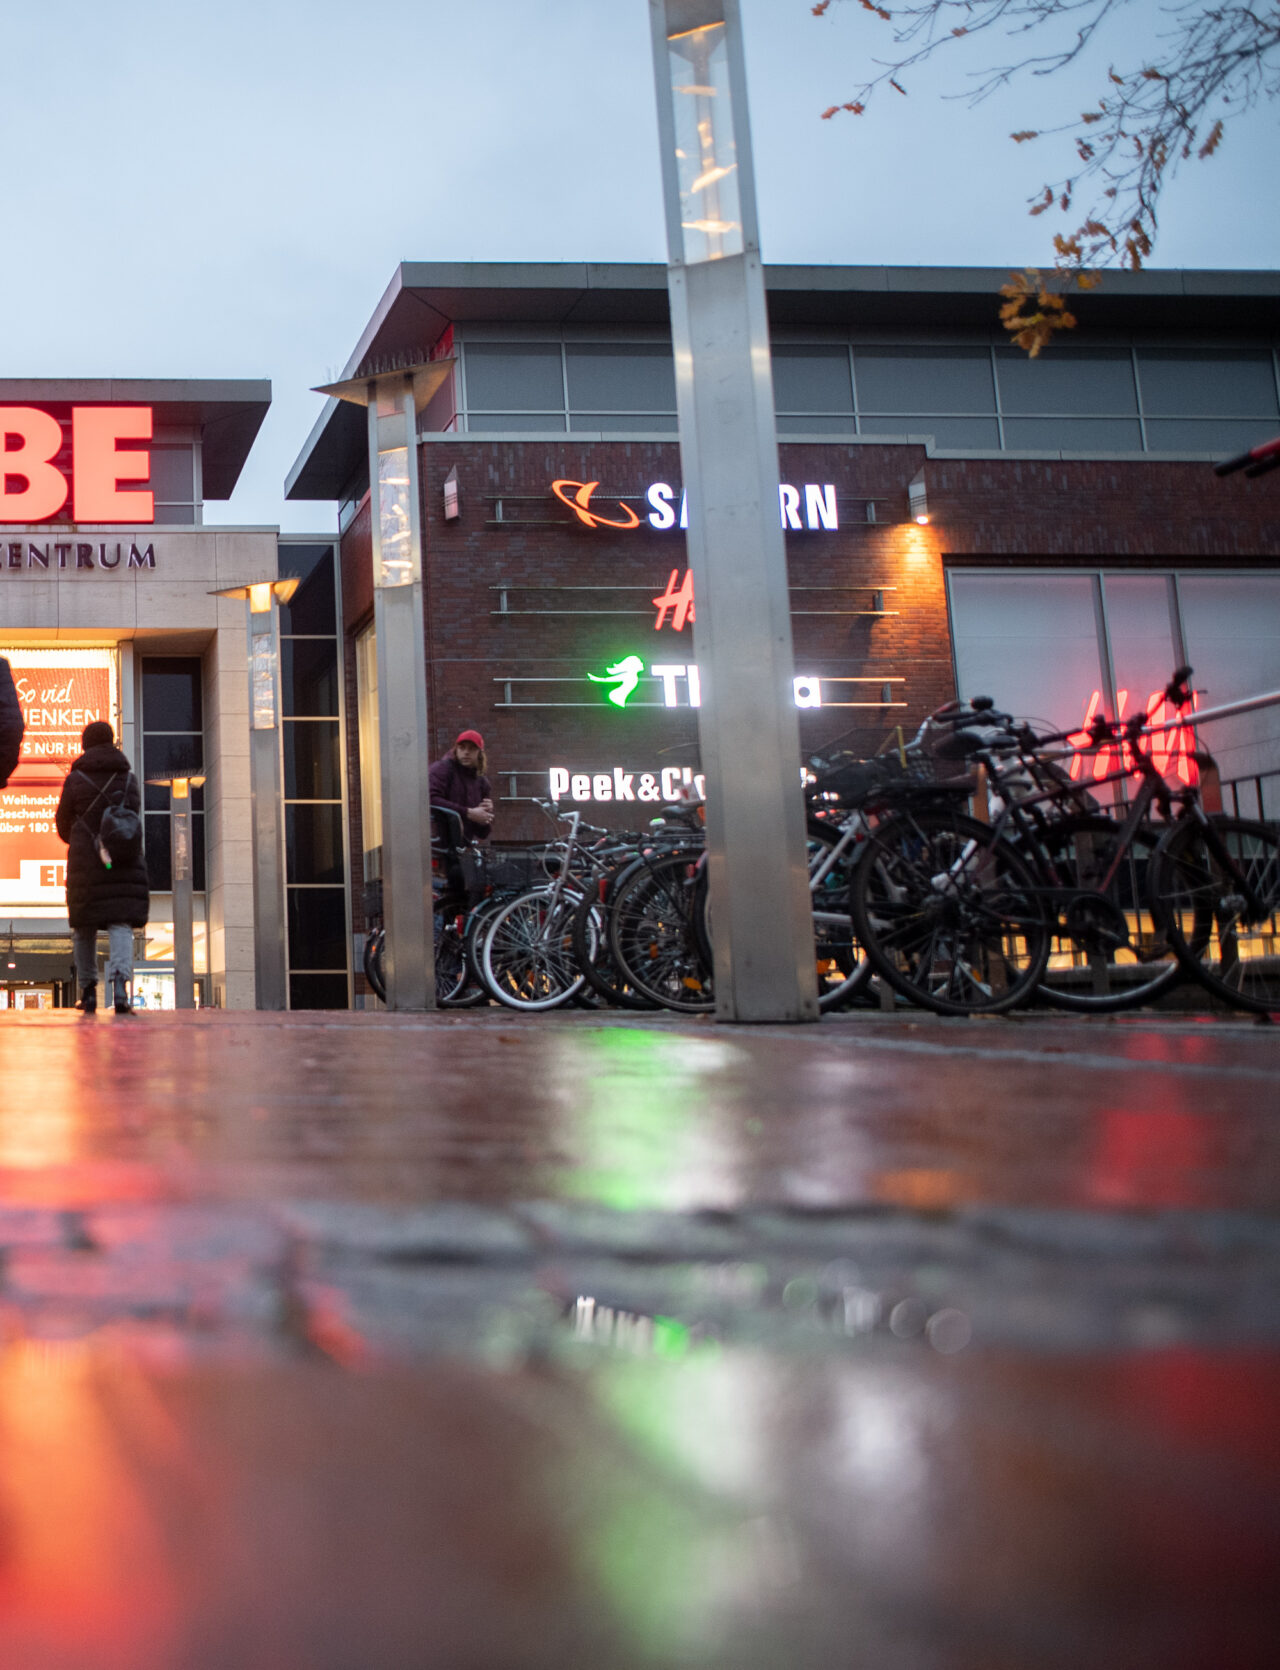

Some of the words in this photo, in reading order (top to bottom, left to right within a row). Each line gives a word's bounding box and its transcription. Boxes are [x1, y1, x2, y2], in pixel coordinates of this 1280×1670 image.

[646, 483, 839, 530] SRN
[15, 677, 36, 703] So
[41, 677, 75, 703] viel
[23, 708, 100, 726] ENKEN
[35, 742, 64, 754] NUR
[67, 742, 84, 754] HI
[2, 794, 59, 805] Weihnacht
[0, 822, 25, 832] über
[40, 865, 66, 886] EL
